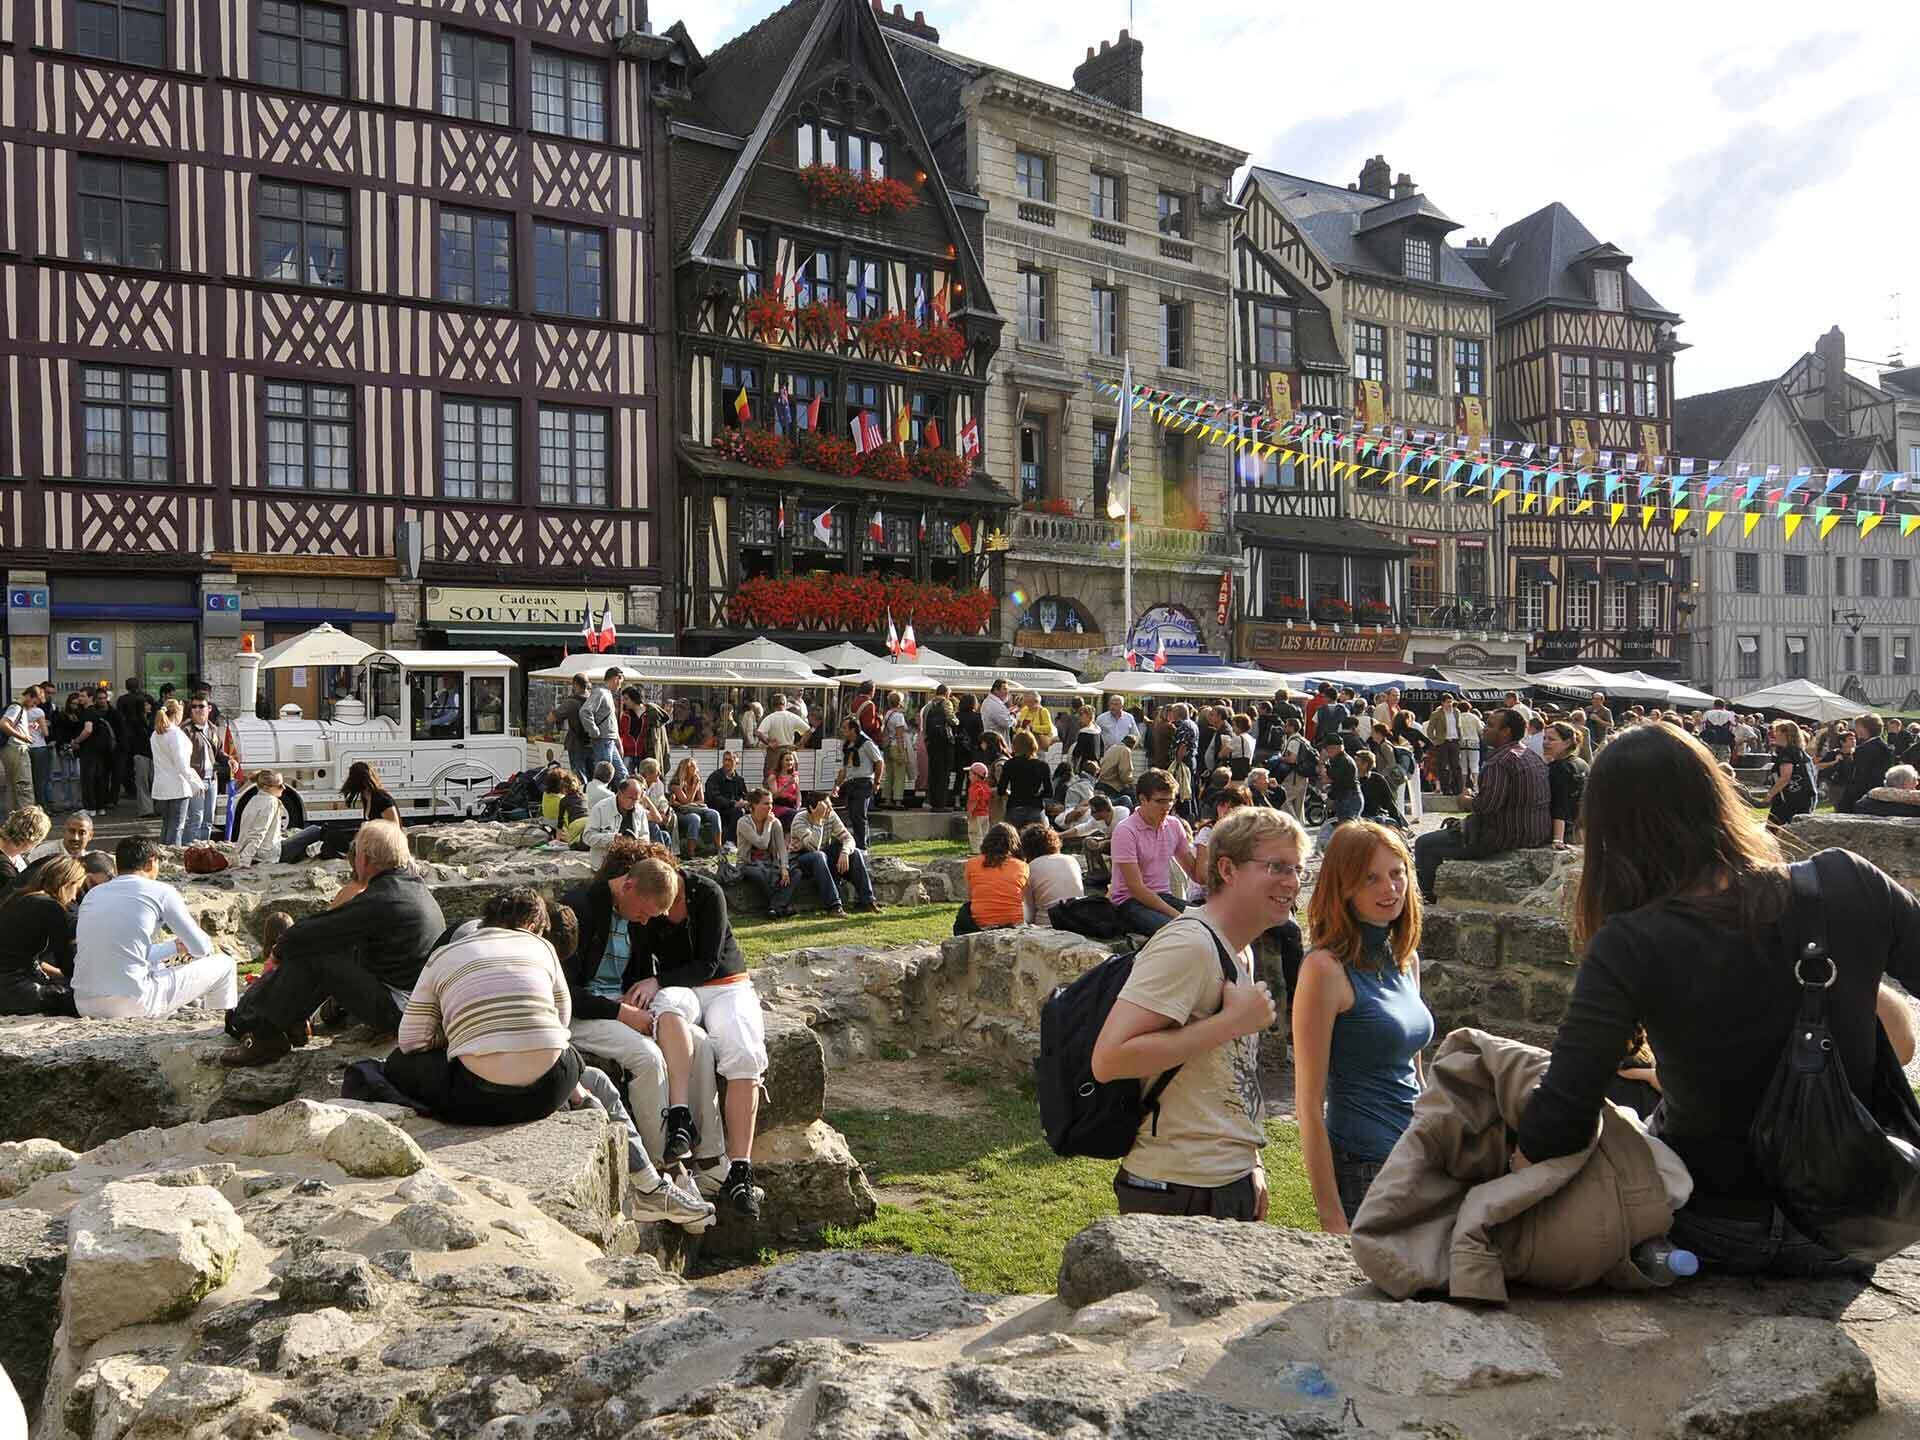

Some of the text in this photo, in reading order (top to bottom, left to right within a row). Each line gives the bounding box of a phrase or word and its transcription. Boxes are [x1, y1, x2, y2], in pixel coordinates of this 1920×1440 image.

[499, 593, 558, 606] Cadeaux
[1218, 571, 1230, 625] TABAC
[449, 606, 606, 624] SOUVENIRS
[1280, 636, 1376, 652] LES MARAICHERS
[1400, 689, 1439, 701] ICHERS
